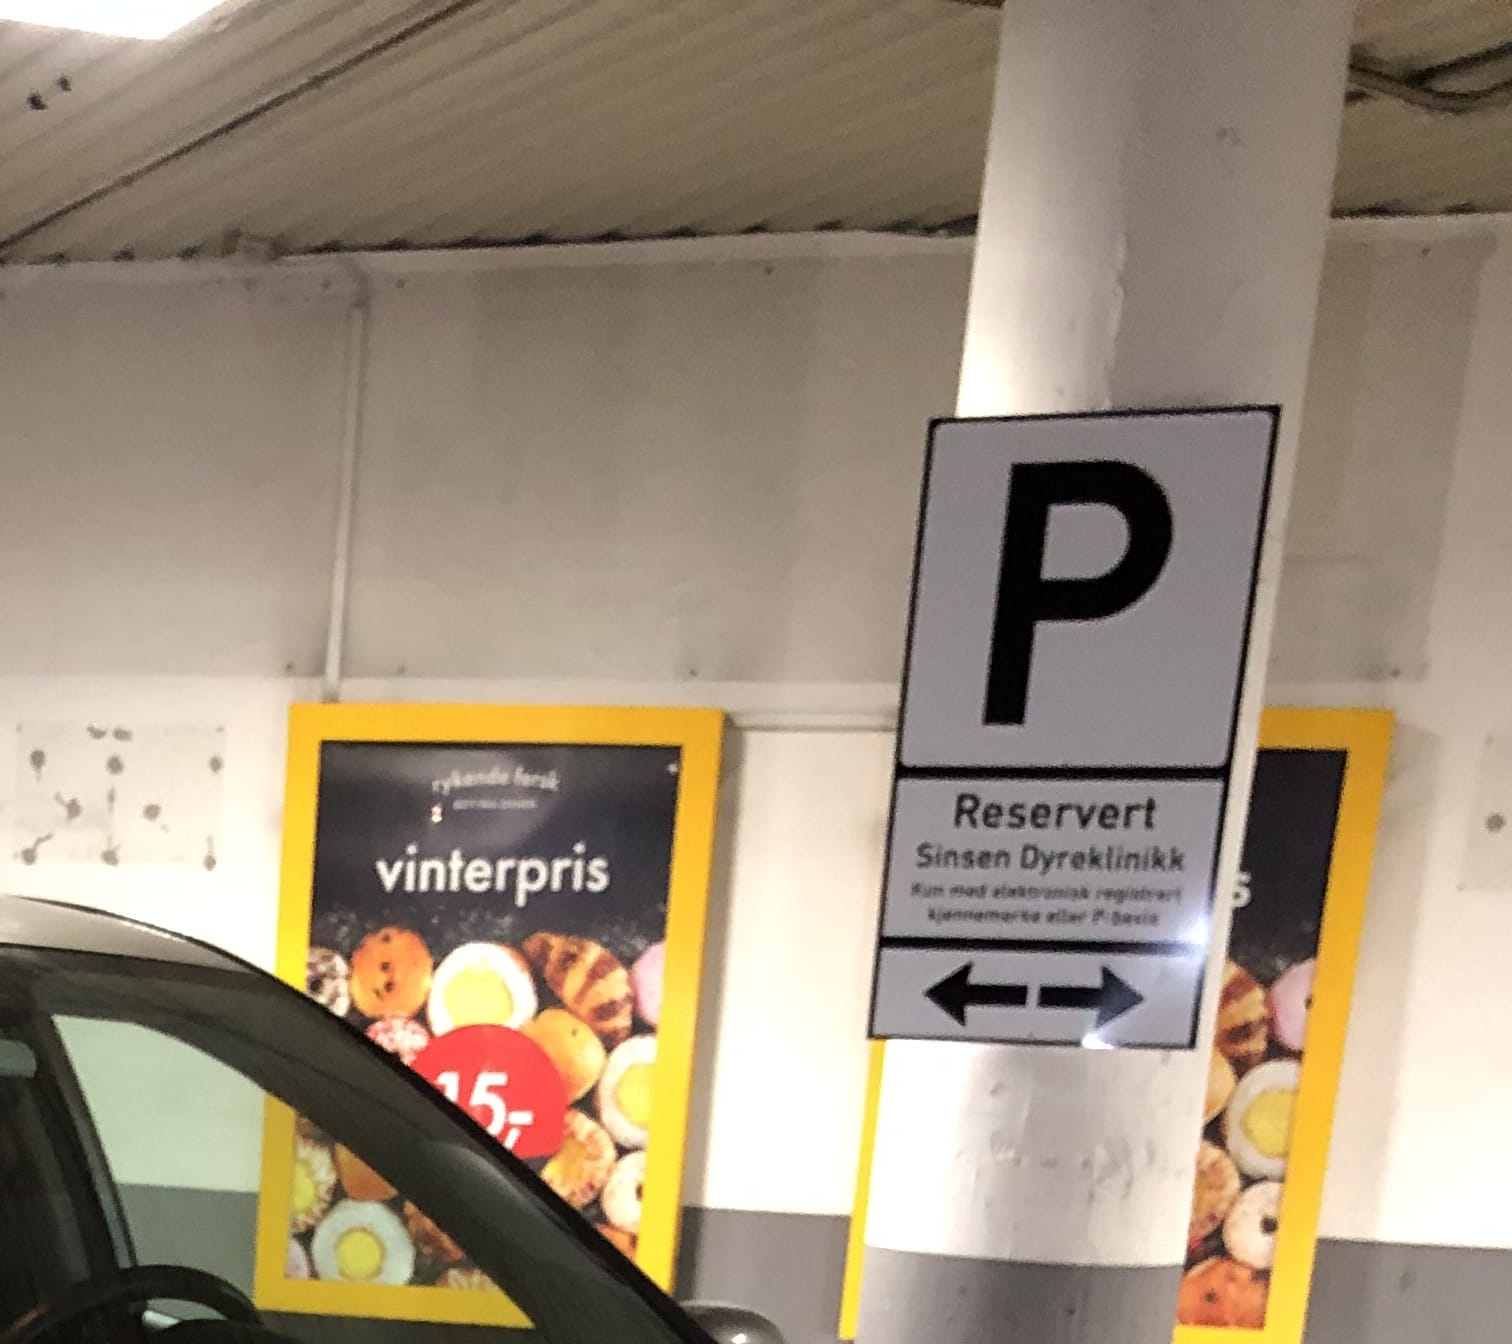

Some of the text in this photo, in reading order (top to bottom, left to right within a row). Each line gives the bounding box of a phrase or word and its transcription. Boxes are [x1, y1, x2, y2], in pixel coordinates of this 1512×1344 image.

[983, 459, 1173, 726] P
[953, 792, 1157, 831] Reservert
[375, 840, 611, 908] vinterpris
[915, 841, 1185, 876] Sinsen Dyreklinikk
